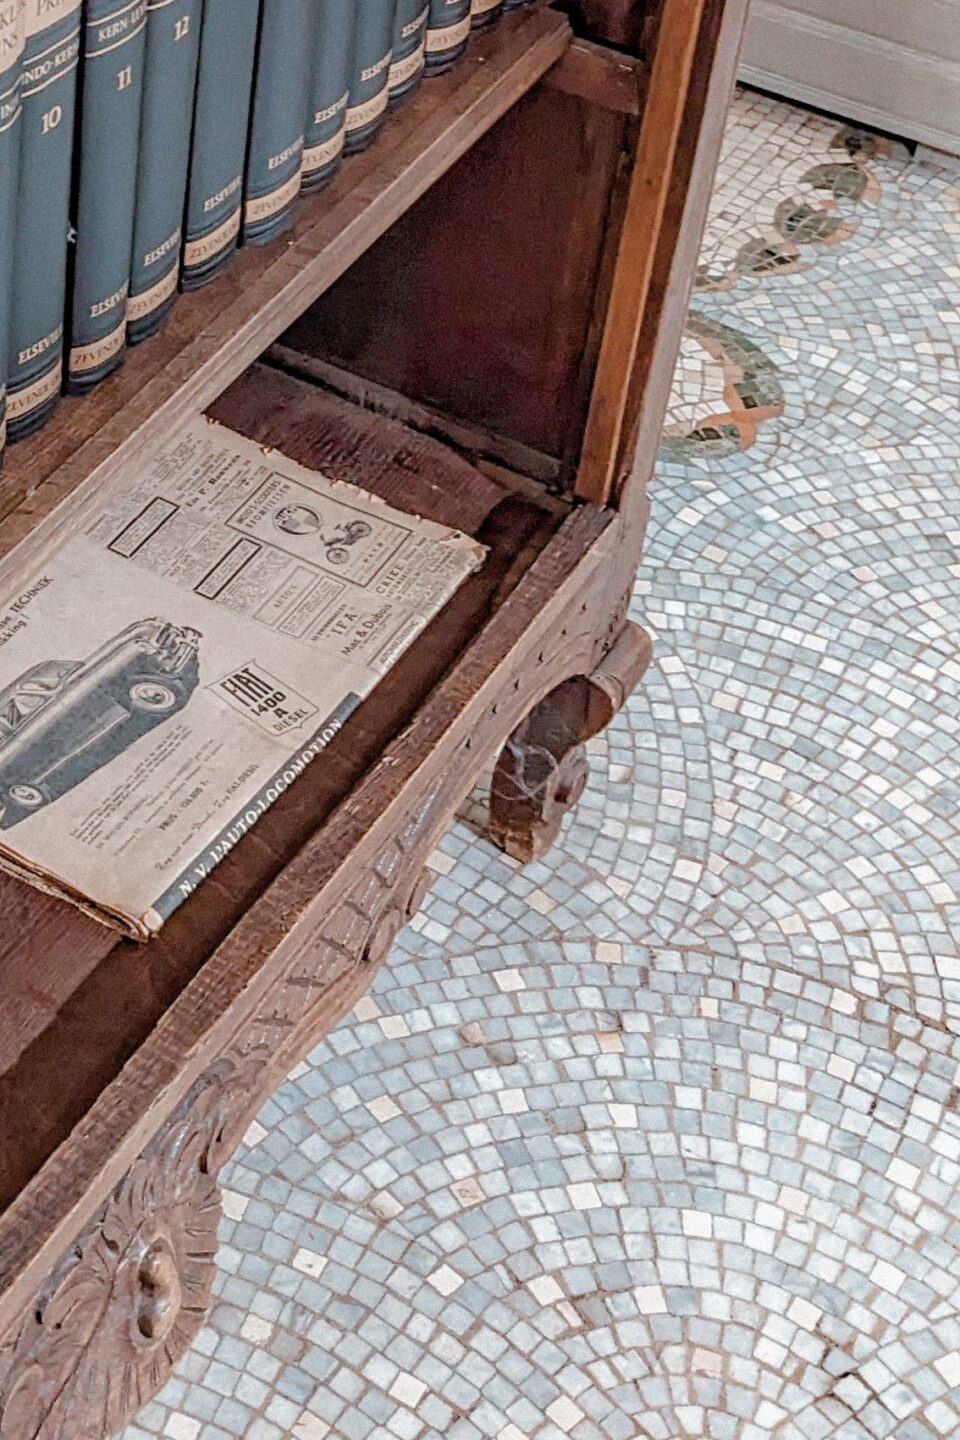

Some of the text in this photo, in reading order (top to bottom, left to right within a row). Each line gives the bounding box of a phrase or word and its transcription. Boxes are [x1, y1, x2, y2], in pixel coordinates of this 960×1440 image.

[174, 15, 189, 41] 12
[117, 65, 132, 91] 11
[41, 105, 61, 134] 10
[341, 603, 393, 656] Mas & Dubois
[220, 667, 274, 707] FIAT
[251, 691, 287, 716] 1400
[273, 707, 289, 719] A
[272, 709, 309, 731] DIESEL
